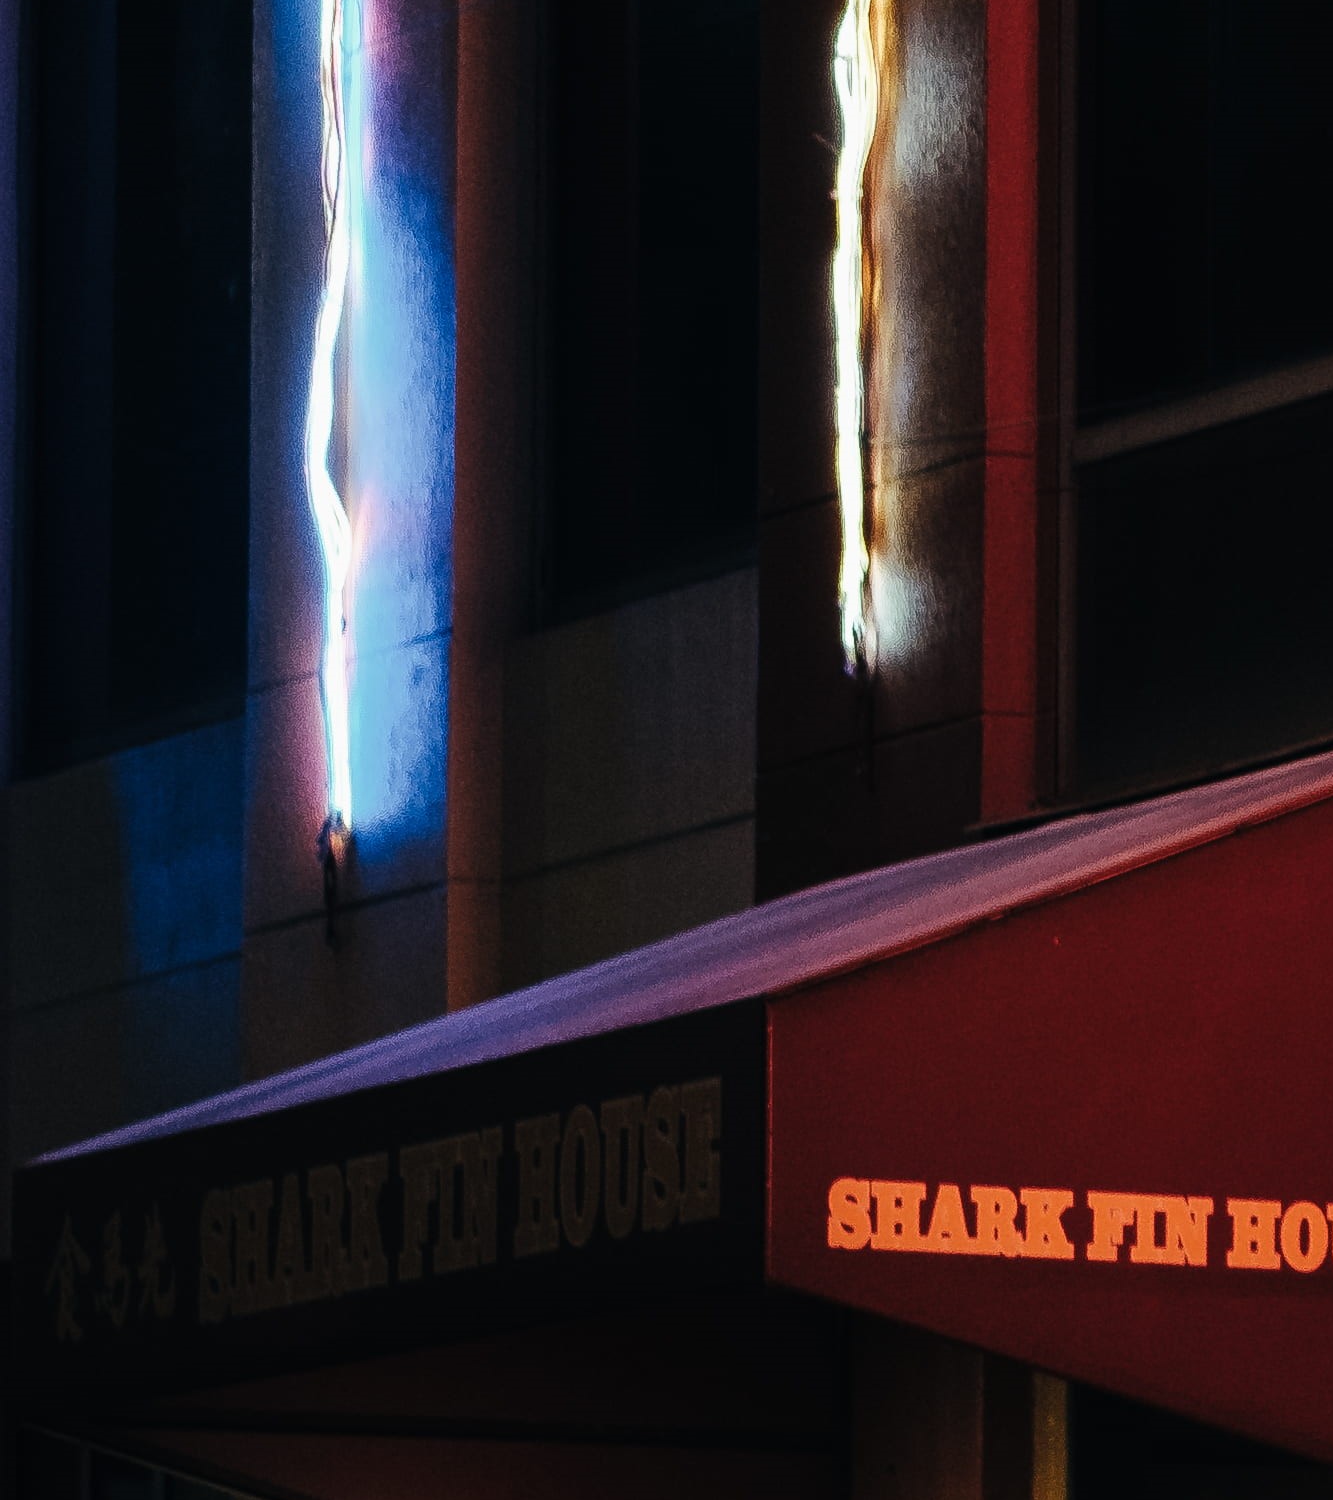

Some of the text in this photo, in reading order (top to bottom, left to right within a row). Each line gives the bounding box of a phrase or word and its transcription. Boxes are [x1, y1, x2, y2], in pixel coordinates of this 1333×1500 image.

[198, 1076, 723, 1325] SHARK FIN HOUSE
[827, 1177, 1074, 1260] SHARK
[1087, 1190, 1214, 1267] FIN
